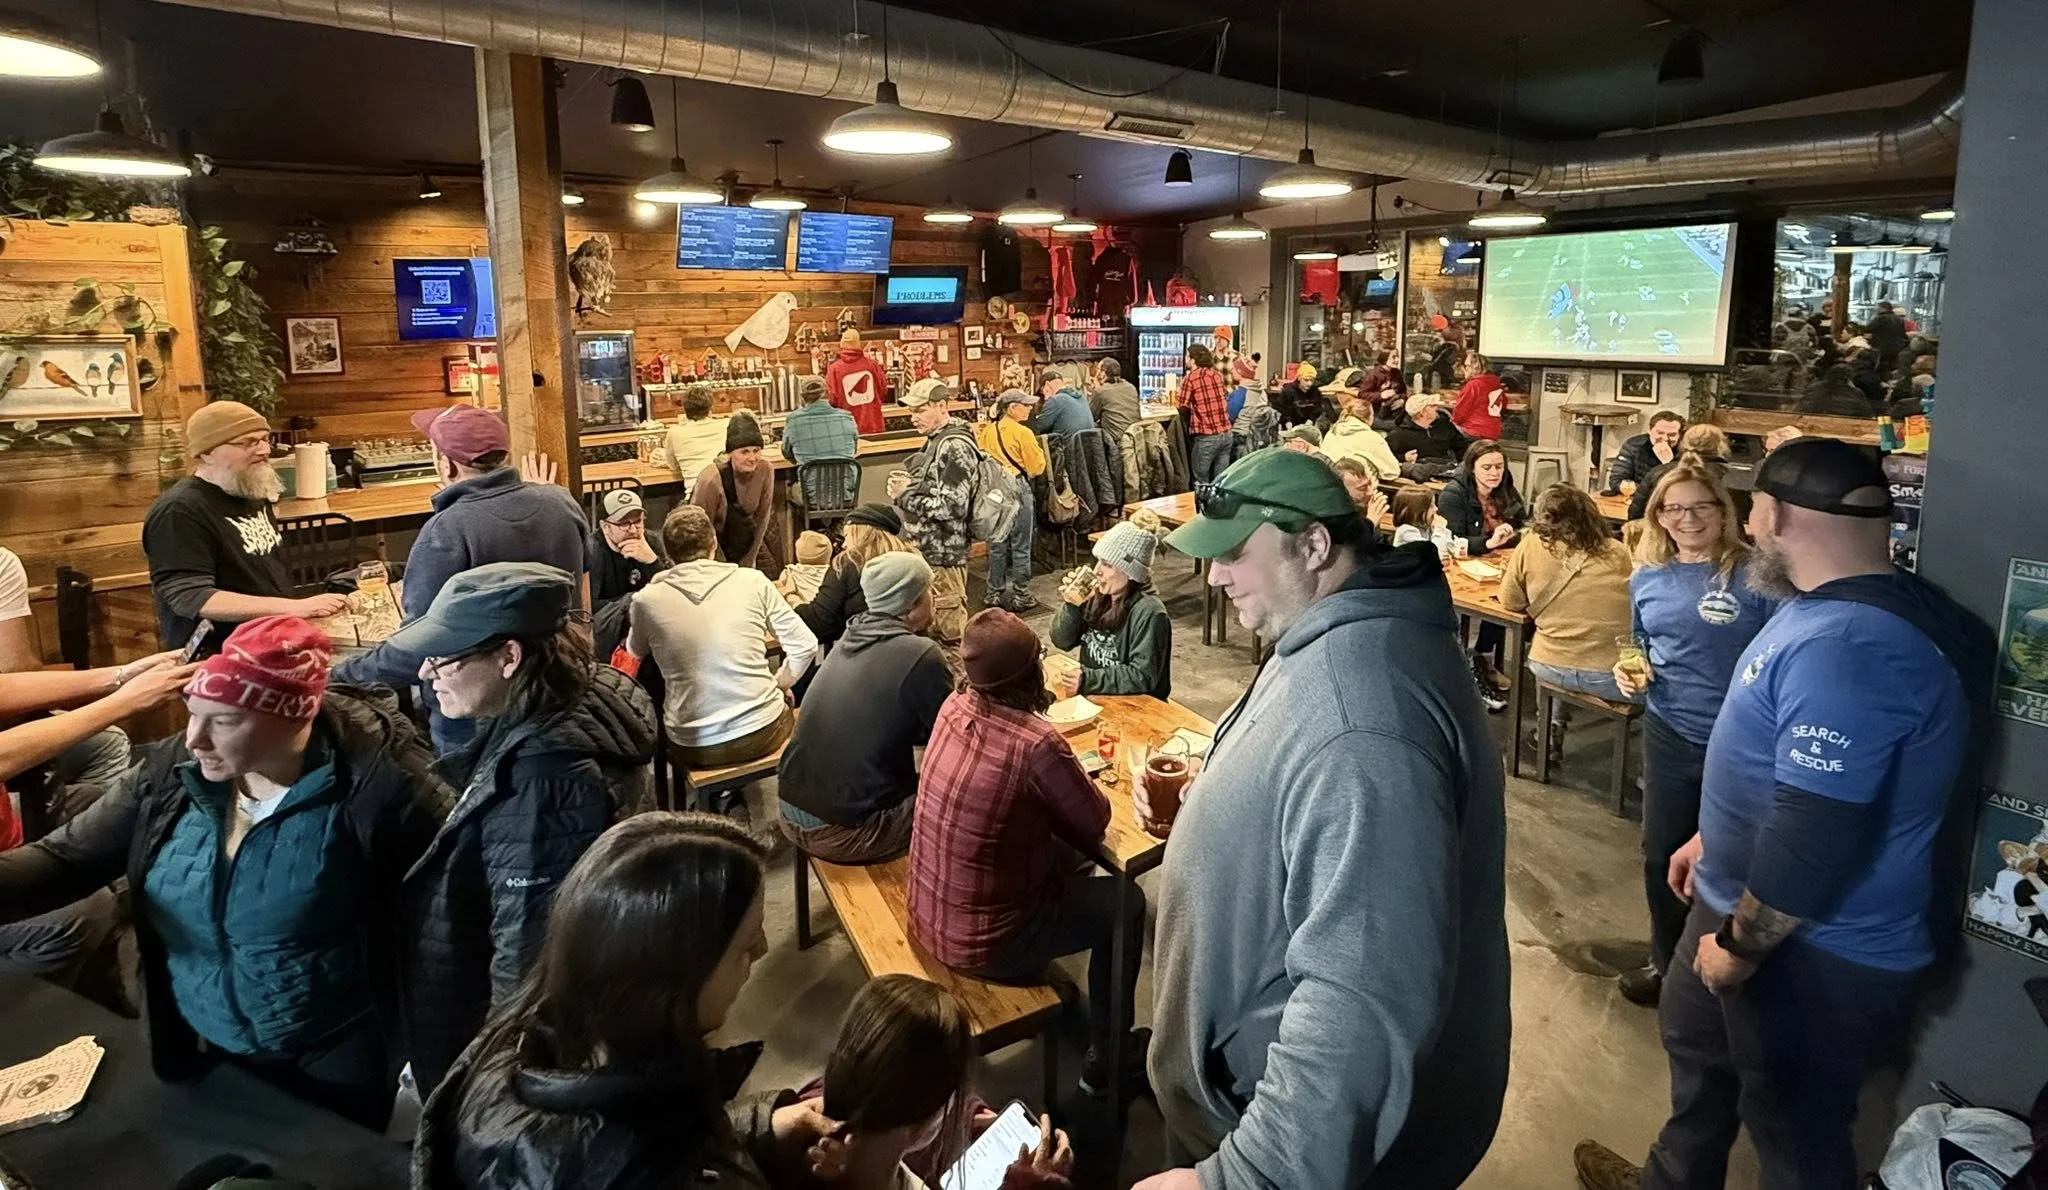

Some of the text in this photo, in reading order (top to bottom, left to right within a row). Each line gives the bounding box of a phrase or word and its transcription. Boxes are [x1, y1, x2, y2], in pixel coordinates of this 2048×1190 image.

[2015, 563, 2048, 579] AN
[1791, 725, 1851, 749] SEARCH
[1810, 741, 1821, 754] &
[1789, 749, 1844, 772] RESCUE
[1988, 793, 2028, 811] AND
[514, 876, 551, 887] Colu
